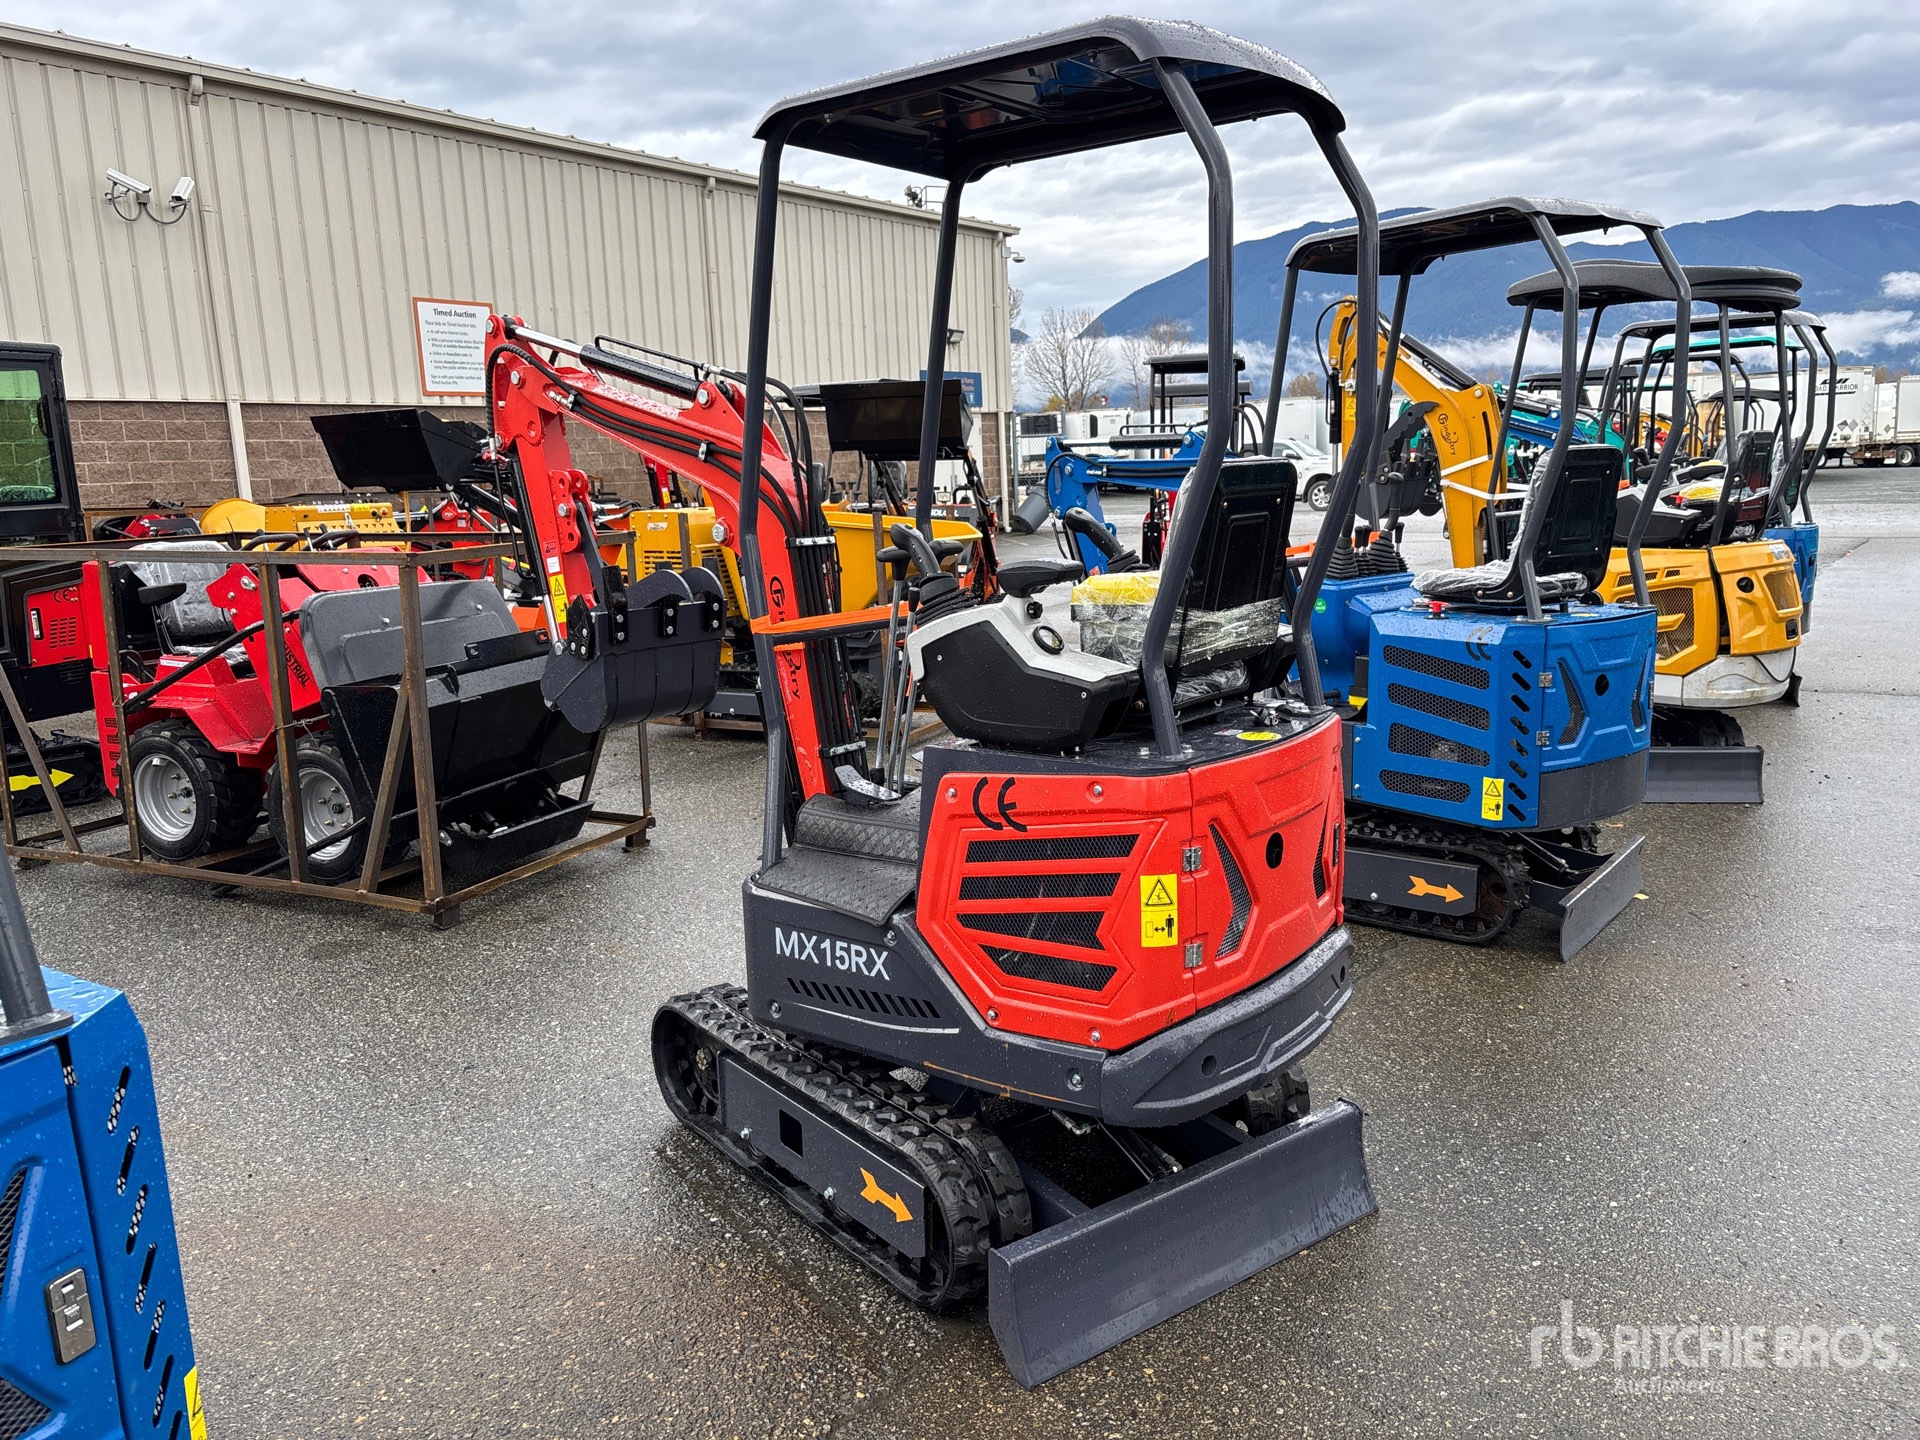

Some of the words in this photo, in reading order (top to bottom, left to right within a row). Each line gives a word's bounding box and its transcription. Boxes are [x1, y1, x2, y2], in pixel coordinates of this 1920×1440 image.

[433, 308, 452, 317] Timed
[454, 310, 476, 318] Auction
[284, 644, 310, 687] USTRIAL
[973, 776, 1027, 832] CE
[775, 927, 890, 981] MX15RX
